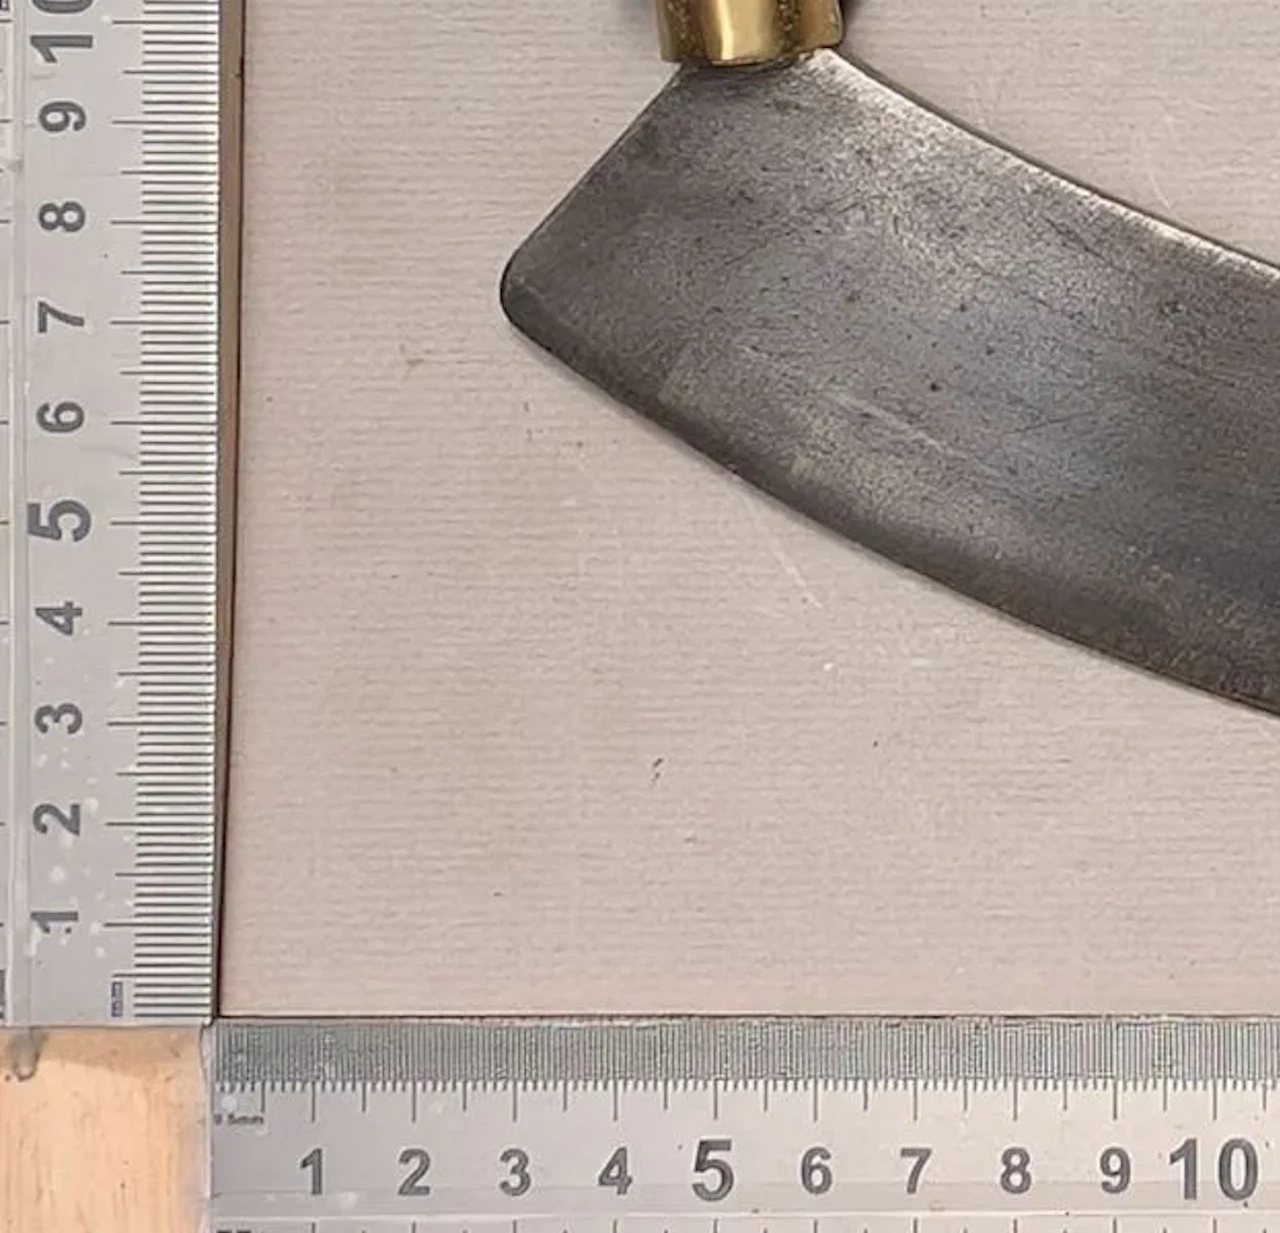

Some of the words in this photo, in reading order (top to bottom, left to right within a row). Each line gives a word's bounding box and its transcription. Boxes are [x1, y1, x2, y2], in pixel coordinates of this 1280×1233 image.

[38, 101, 86, 132] 9
[38, 202, 86, 232] 8
[38, 301, 84, 333] 7
[36, 402, 84, 433] 6
[28, 500, 91, 542] 5
[35, 602, 83, 636] 4
[35, 703, 82, 734] 3
[33, 804, 80, 836] 2
[31, 912, 78, 934] 1
[301, 1149, 322, 1195] 1
[398, 1149, 430, 1196] 2
[500, 1149, 531, 1196] 3
[598, 1147, 633, 1195] 4
[692, 1139, 734, 1202] 5
[801, 1147, 832, 1195] 6
[900, 1148, 932, 1195] 7
[1000, 1147, 1031, 1194] 8
[1100, 1147, 1131, 1194] 9
[1170, 1138, 1258, 1201] 10
